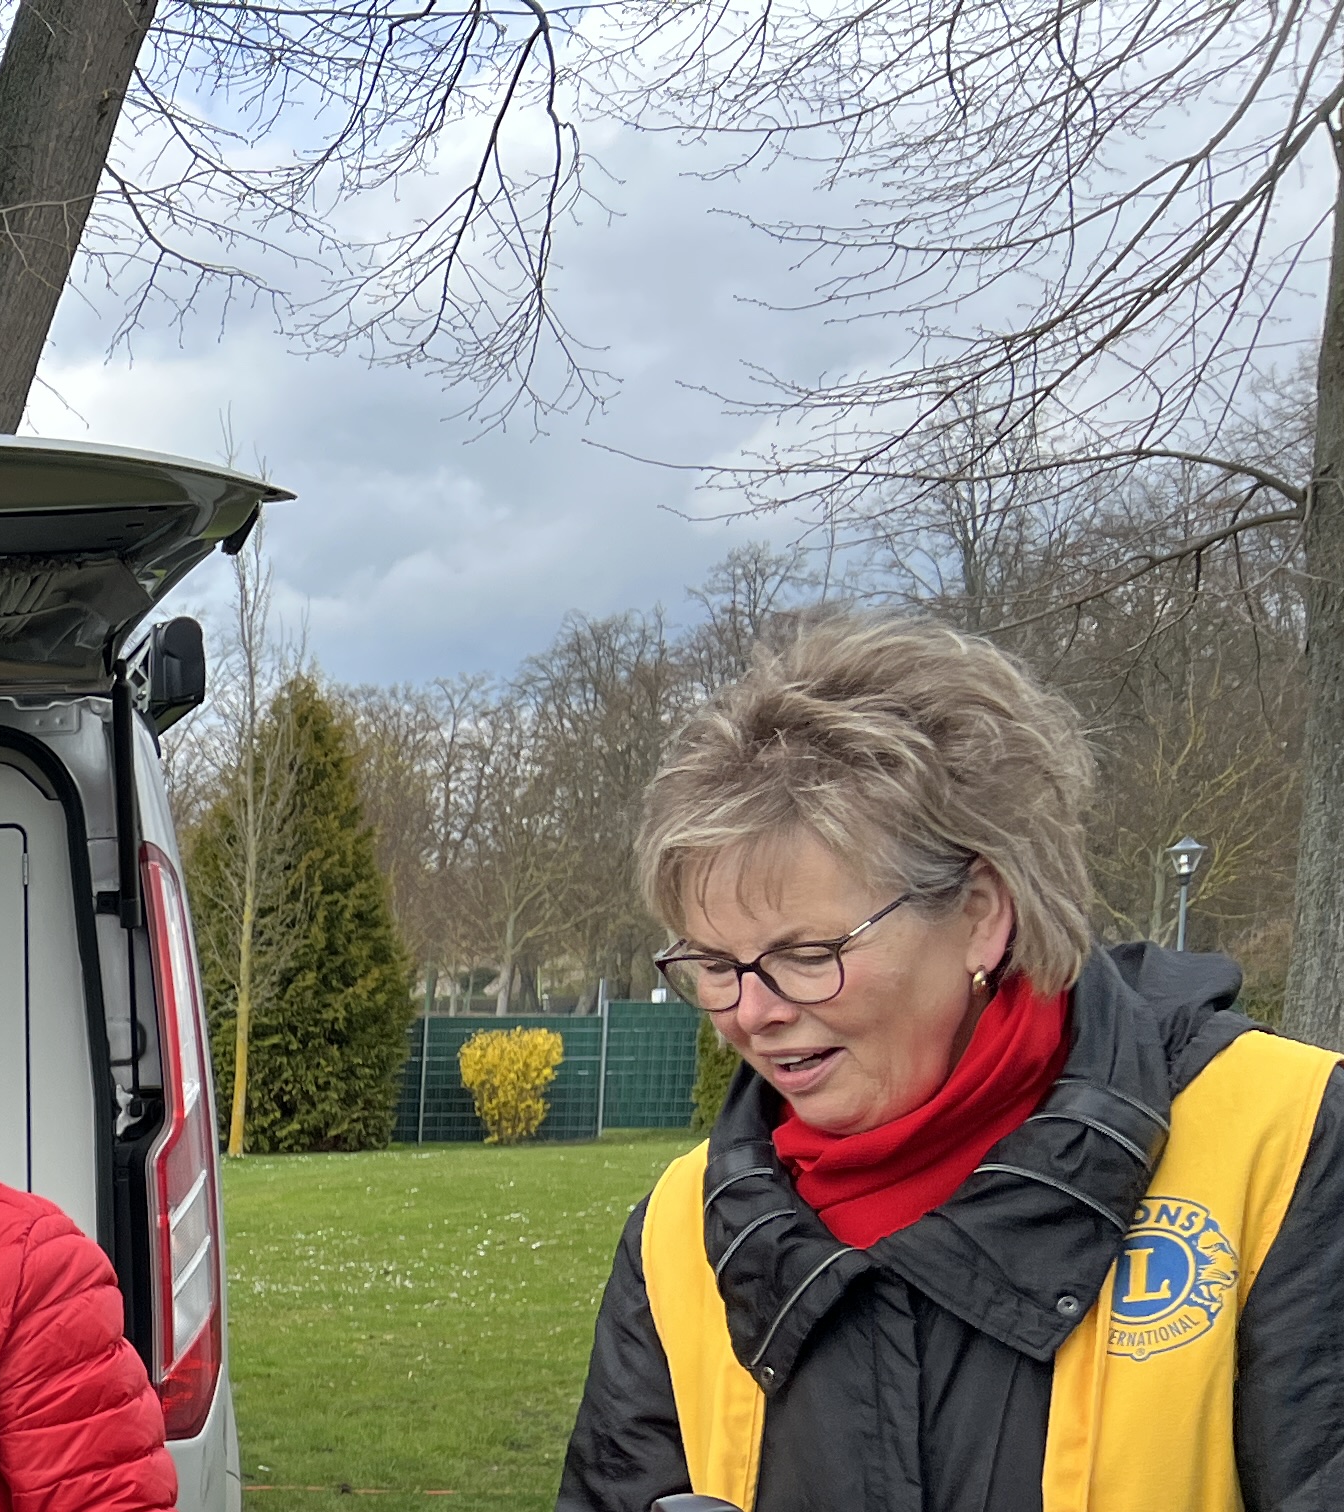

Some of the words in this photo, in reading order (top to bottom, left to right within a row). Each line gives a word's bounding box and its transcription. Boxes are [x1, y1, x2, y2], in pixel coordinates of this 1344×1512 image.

[1130, 1203, 1200, 1232] ONS
[1122, 1247, 1172, 1303] L
[1109, 1313, 1201, 1347] ERNATIONAL
